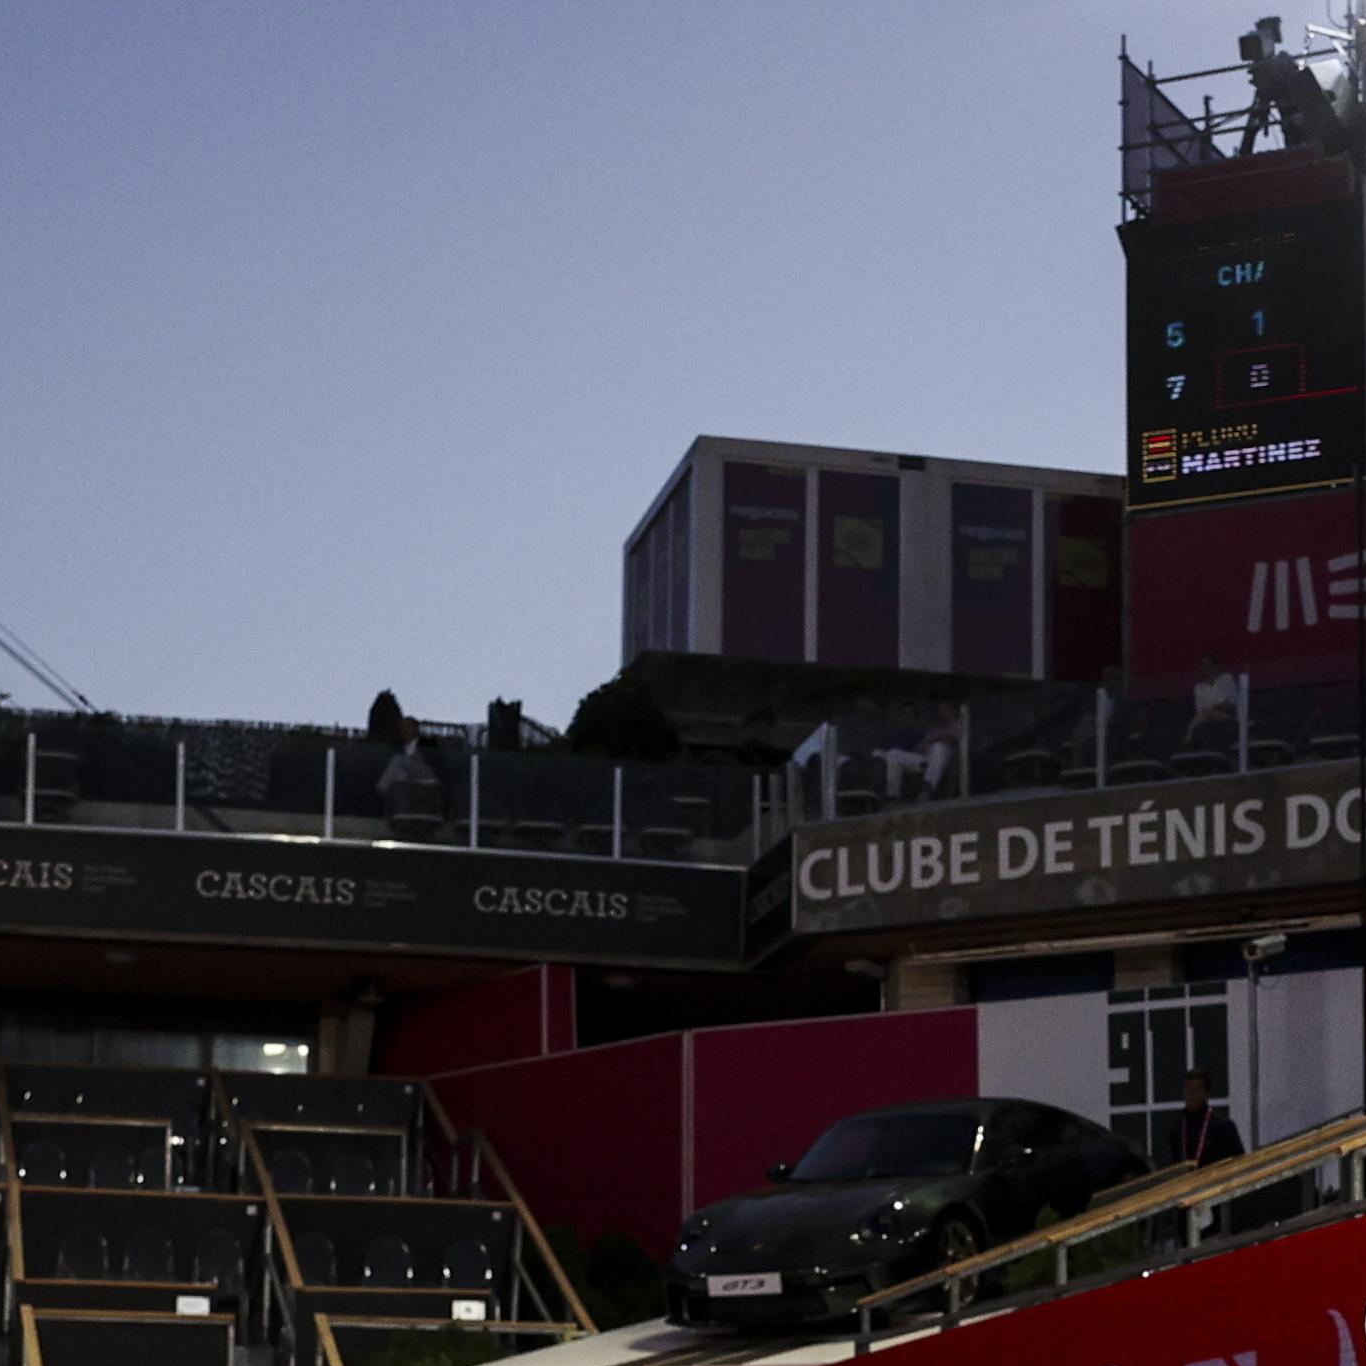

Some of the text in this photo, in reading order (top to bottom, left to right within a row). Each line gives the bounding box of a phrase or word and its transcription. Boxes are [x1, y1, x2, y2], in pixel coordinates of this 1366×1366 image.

[1253, 310, 1265, 336] 1
[1166, 375, 1186, 400] 7
[1182, 438, 1321, 474] MARTINEZ
[799, 831, 981, 901] CLUBE
[998, 821, 1074, 881] DE
[1087, 799, 1267, 870] TÉNIS
[195, 869, 356, 907] CASCAIS
[473, 886, 629, 921] CASCAIS
